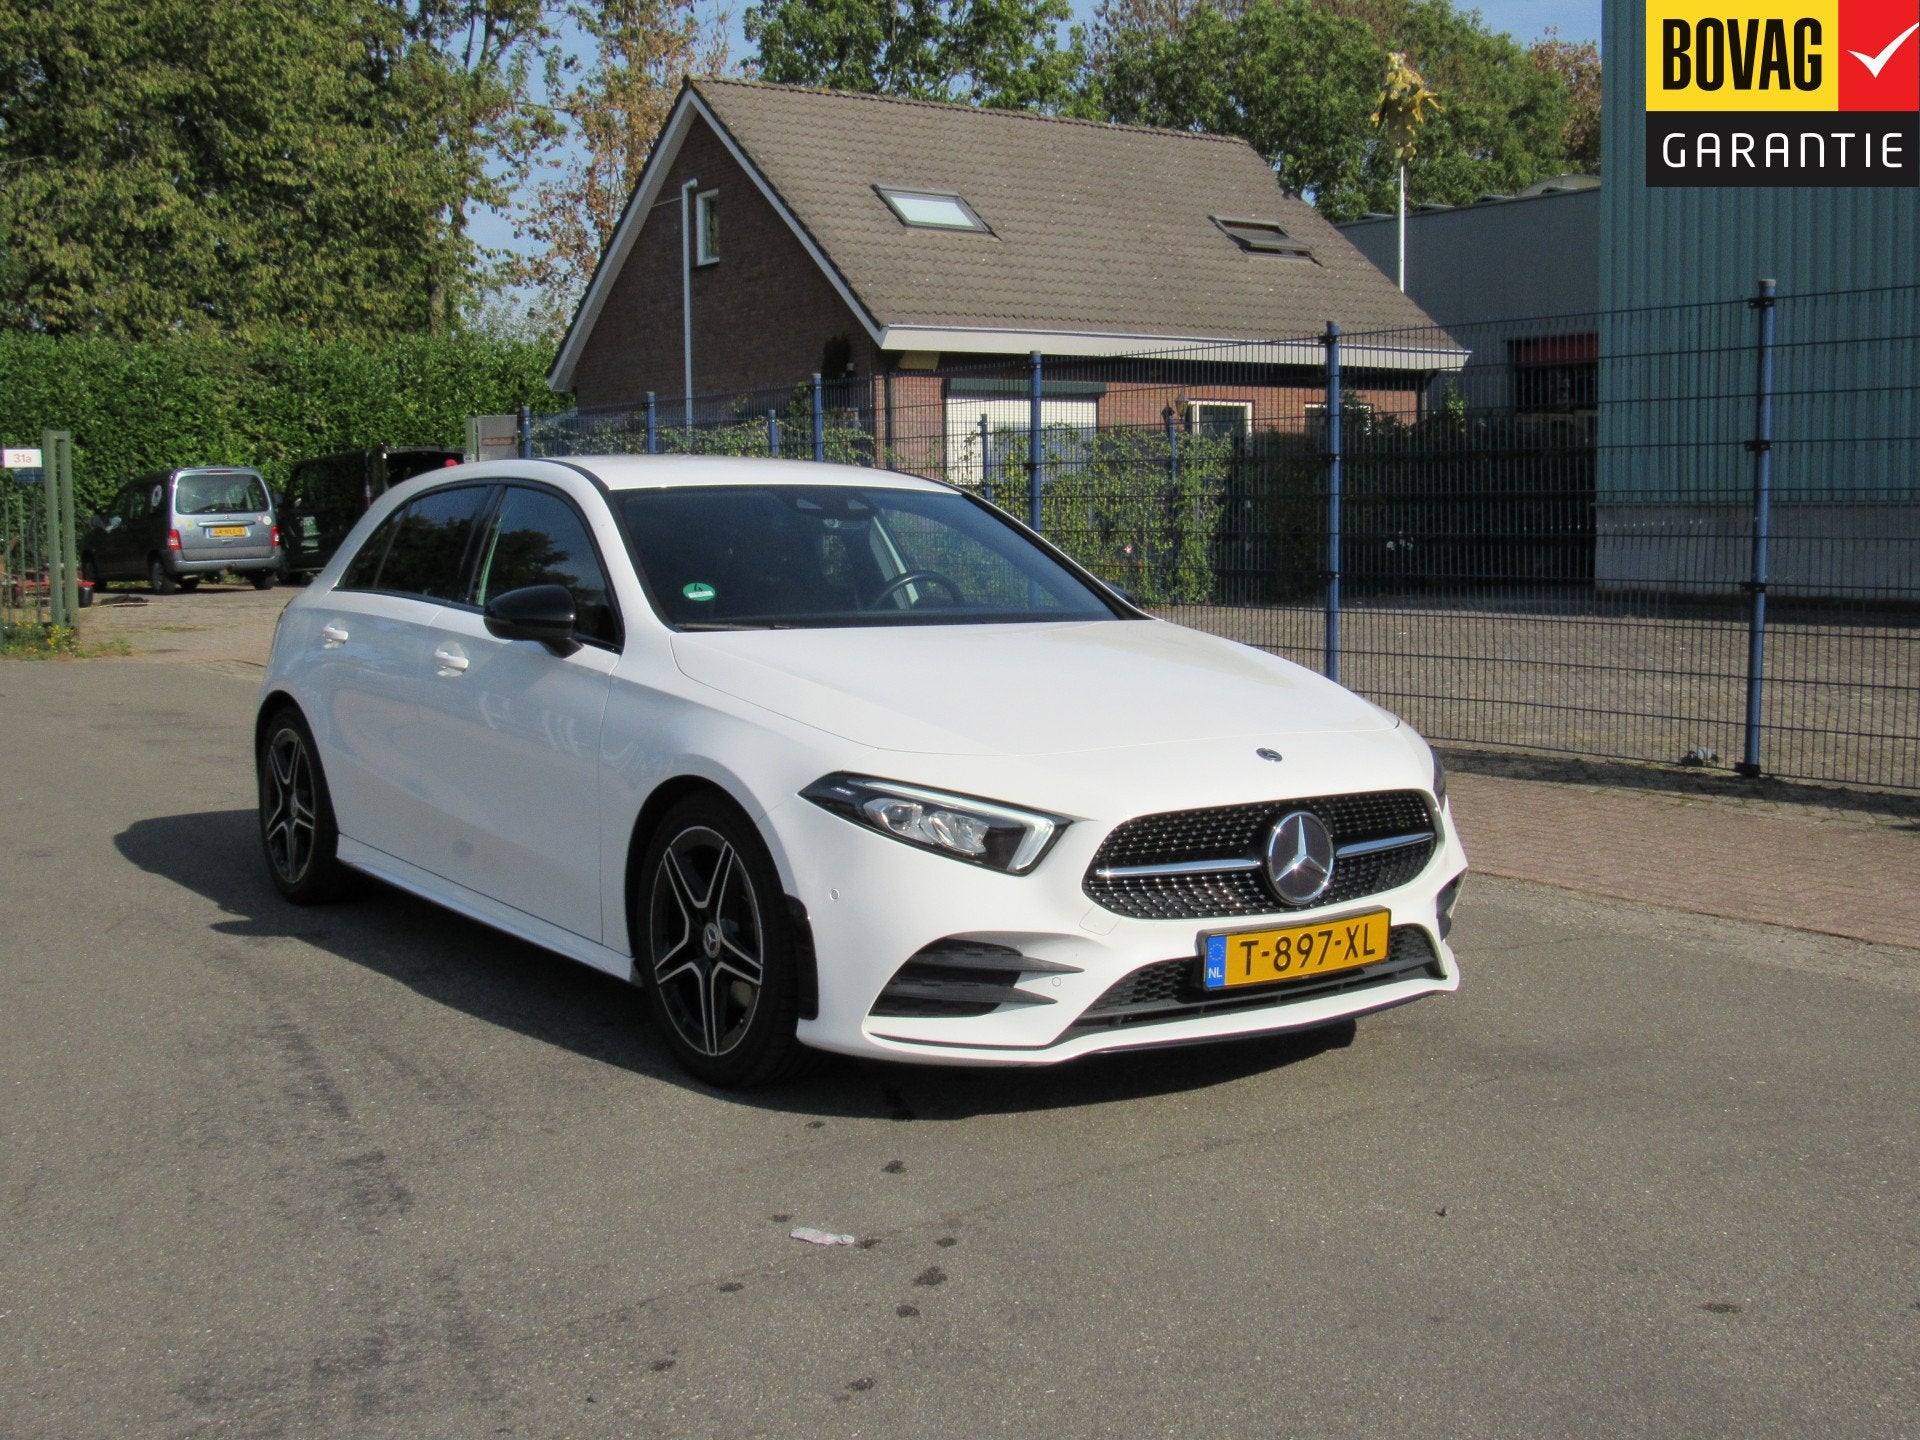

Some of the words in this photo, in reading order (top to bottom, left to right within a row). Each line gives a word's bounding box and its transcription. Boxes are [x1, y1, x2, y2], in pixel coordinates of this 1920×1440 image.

[14, 453, 32, 463] 31a
[1240, 922, 1376, 976] T-897-XL
[1208, 967, 1223, 979] NL
